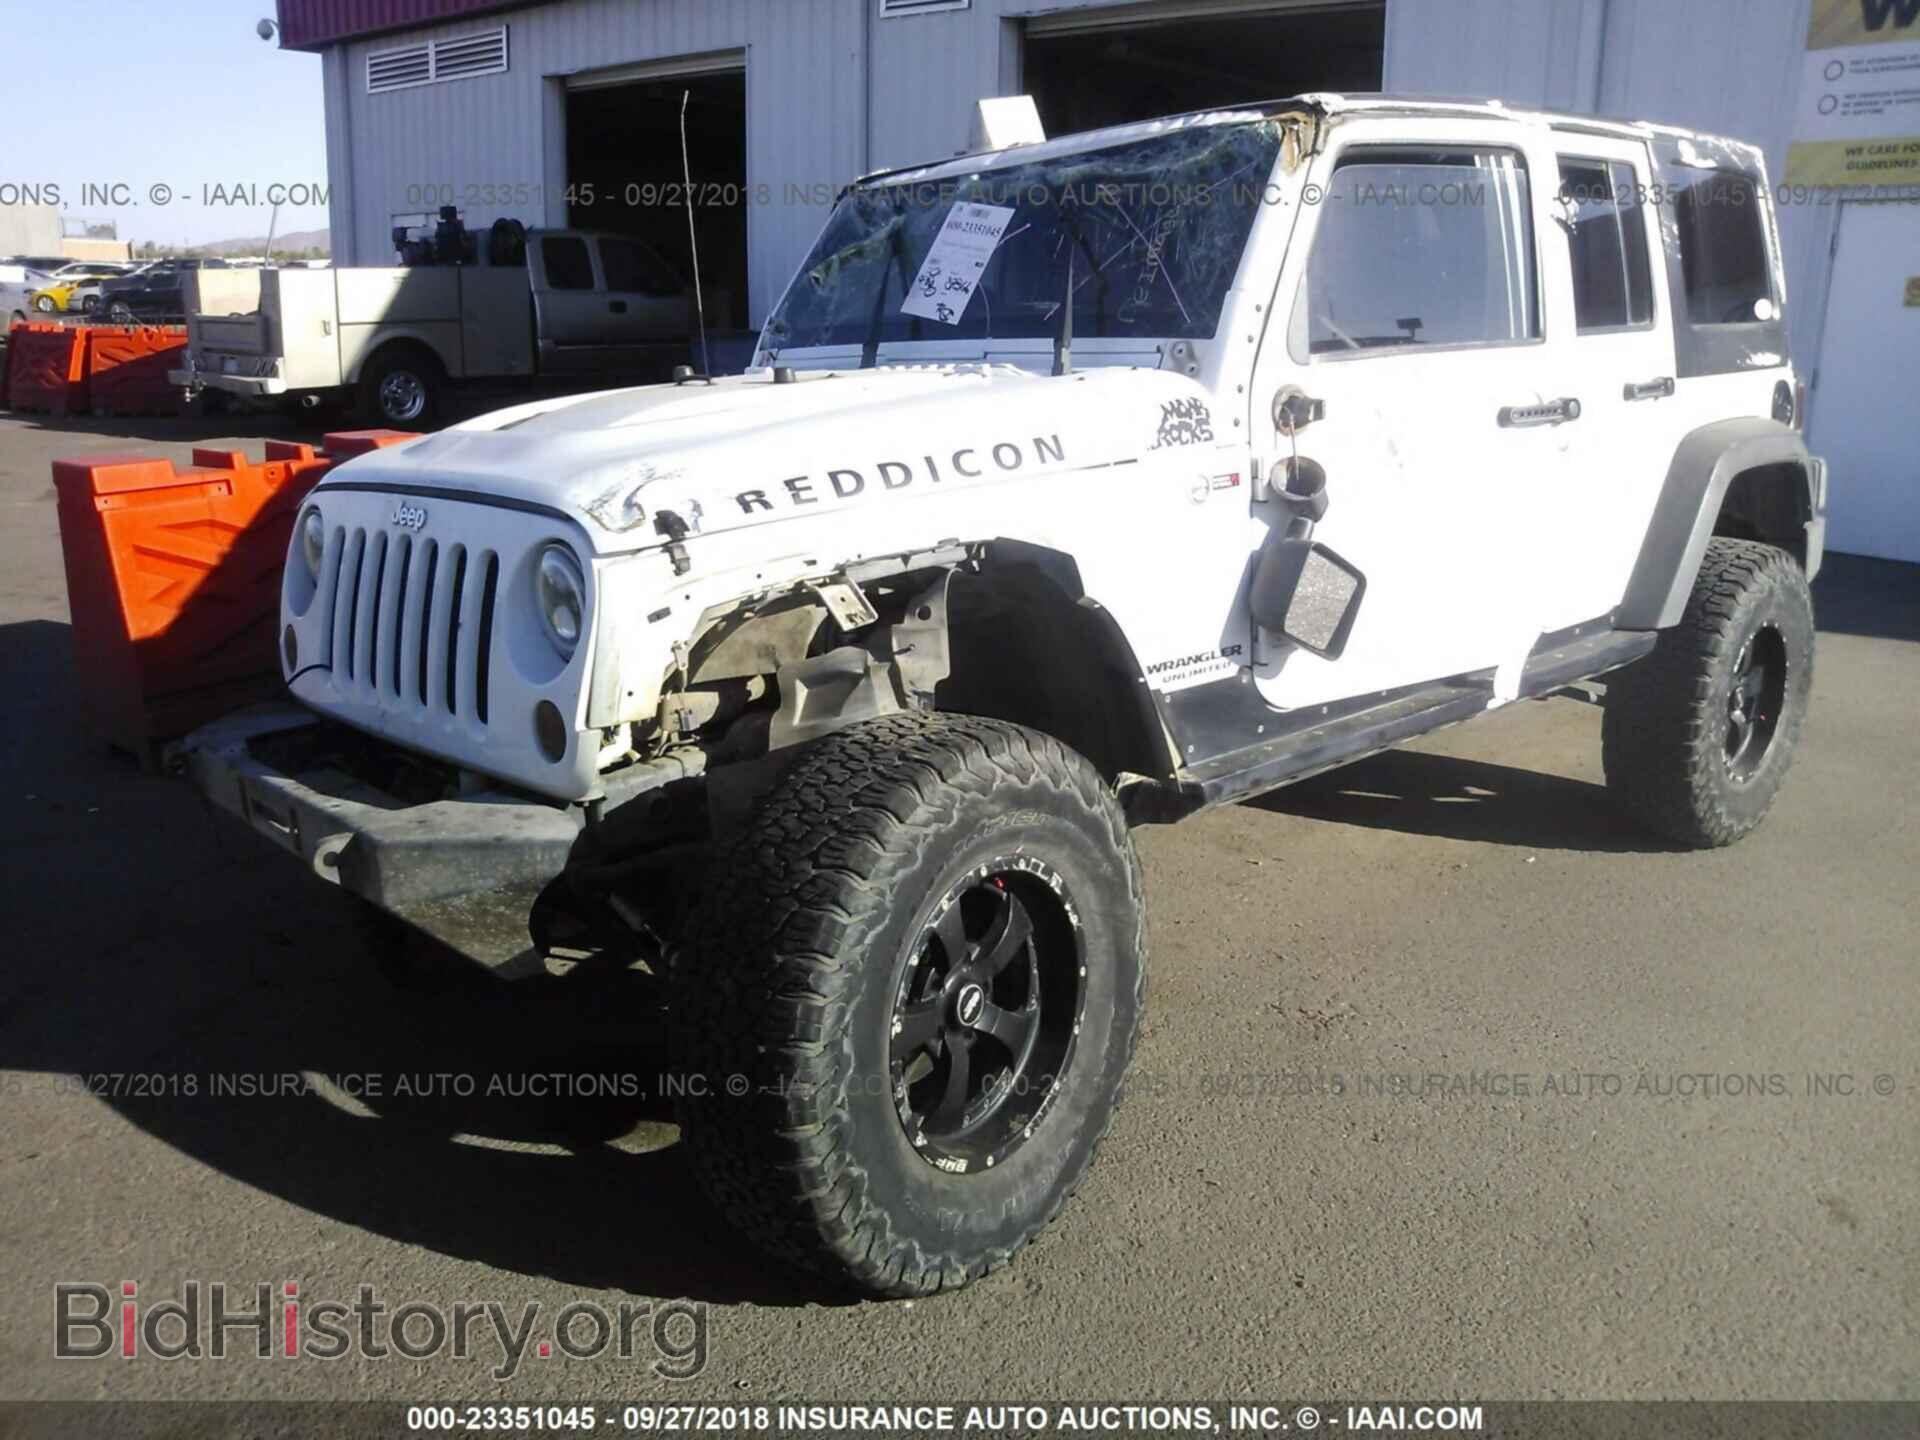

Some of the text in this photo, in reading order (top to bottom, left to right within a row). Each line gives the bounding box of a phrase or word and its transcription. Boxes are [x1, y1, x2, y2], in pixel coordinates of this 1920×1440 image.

[735, 434, 1066, 515] REDDICON
[391, 502, 425, 531] Jeep
[1146, 645, 1242, 675] WRANGLER
